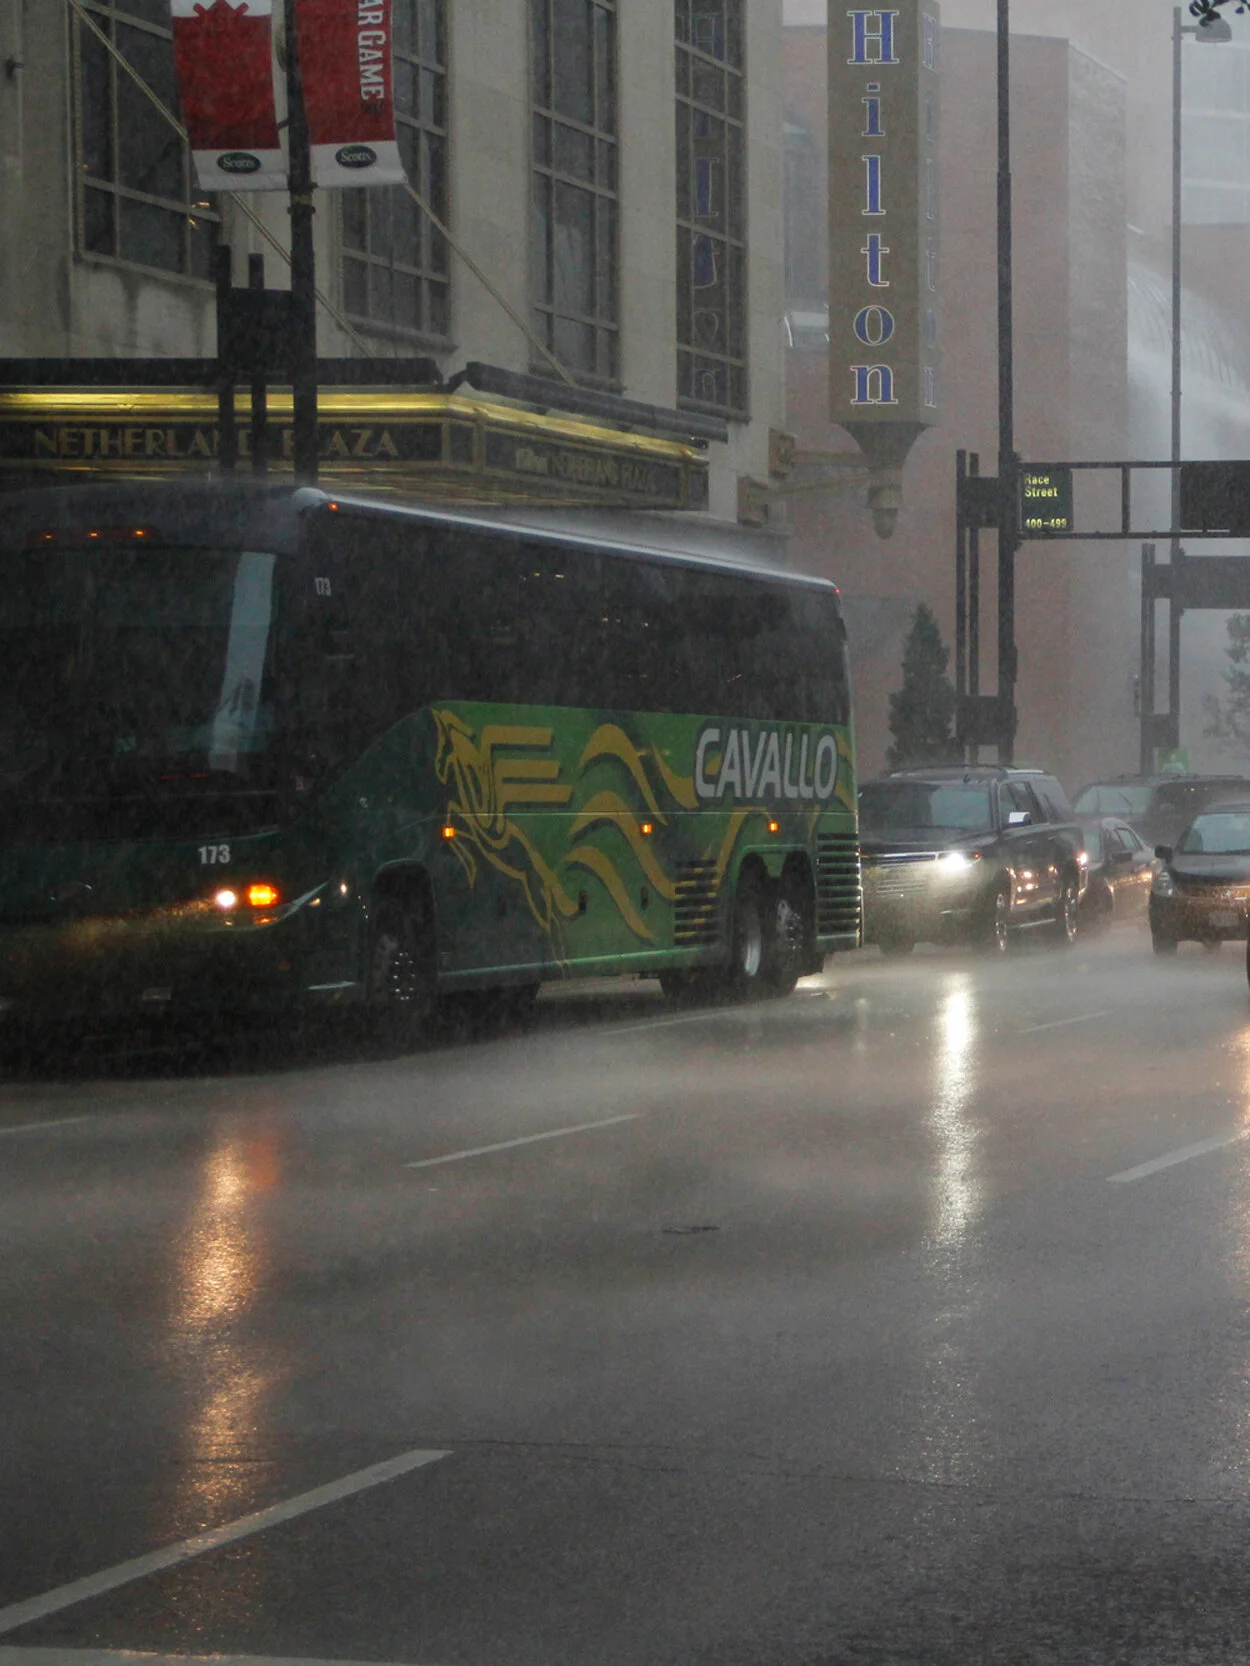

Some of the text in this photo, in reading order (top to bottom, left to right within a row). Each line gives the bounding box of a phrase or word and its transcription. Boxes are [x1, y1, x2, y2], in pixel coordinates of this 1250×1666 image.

[358, 30, 386, 100] GAME
[846, 9, 899, 404] Hilton
[282, 429, 397, 457] AZA
[1024, 473, 1050, 485] Race
[1025, 485, 1058, 498] Street
[1025, 518, 1067, 529] 400-499
[314, 576, 332, 597] 173
[695, 728, 837, 799] CAVALLO
[198, 843, 231, 865] 173
